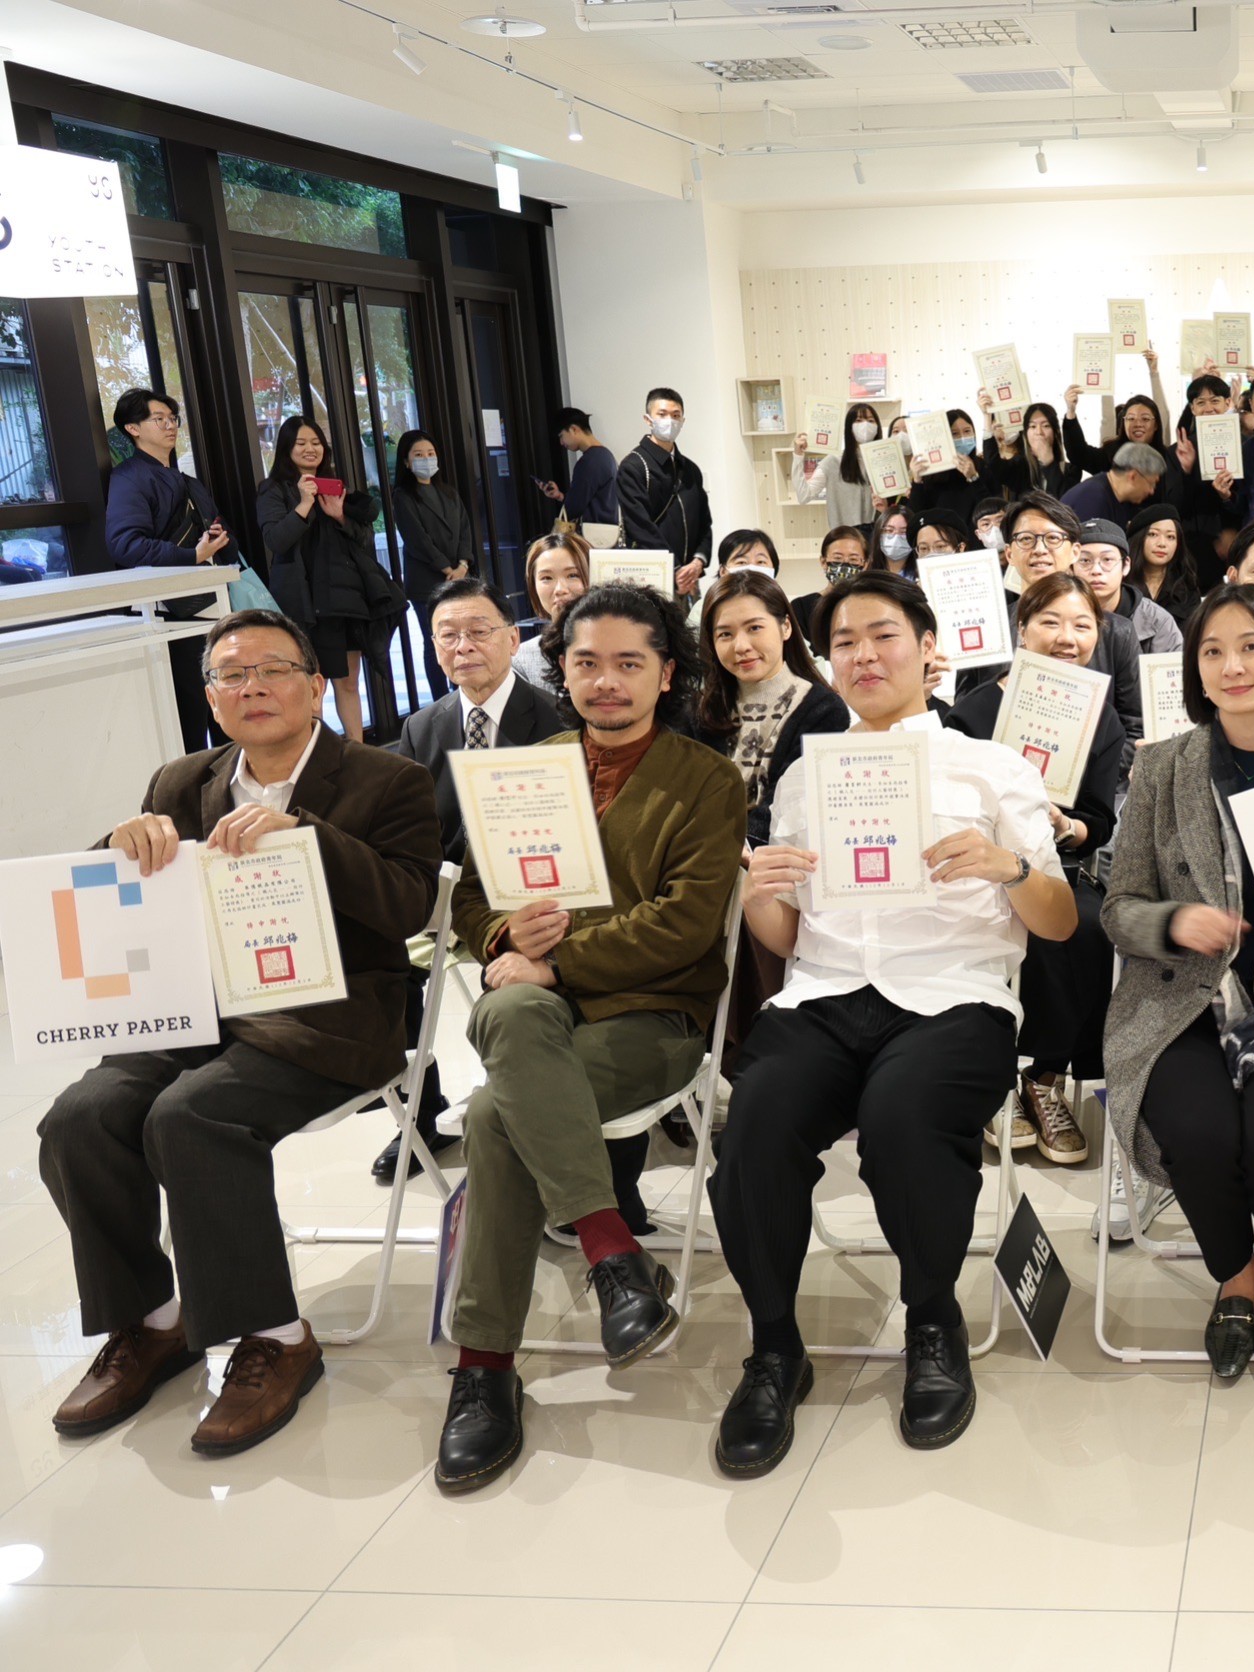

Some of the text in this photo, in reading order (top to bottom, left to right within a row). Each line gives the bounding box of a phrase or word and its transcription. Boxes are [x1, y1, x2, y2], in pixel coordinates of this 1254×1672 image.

[52, 258, 124, 278] STATON
[37, 1015, 193, 1045] CHERRY PAPER
